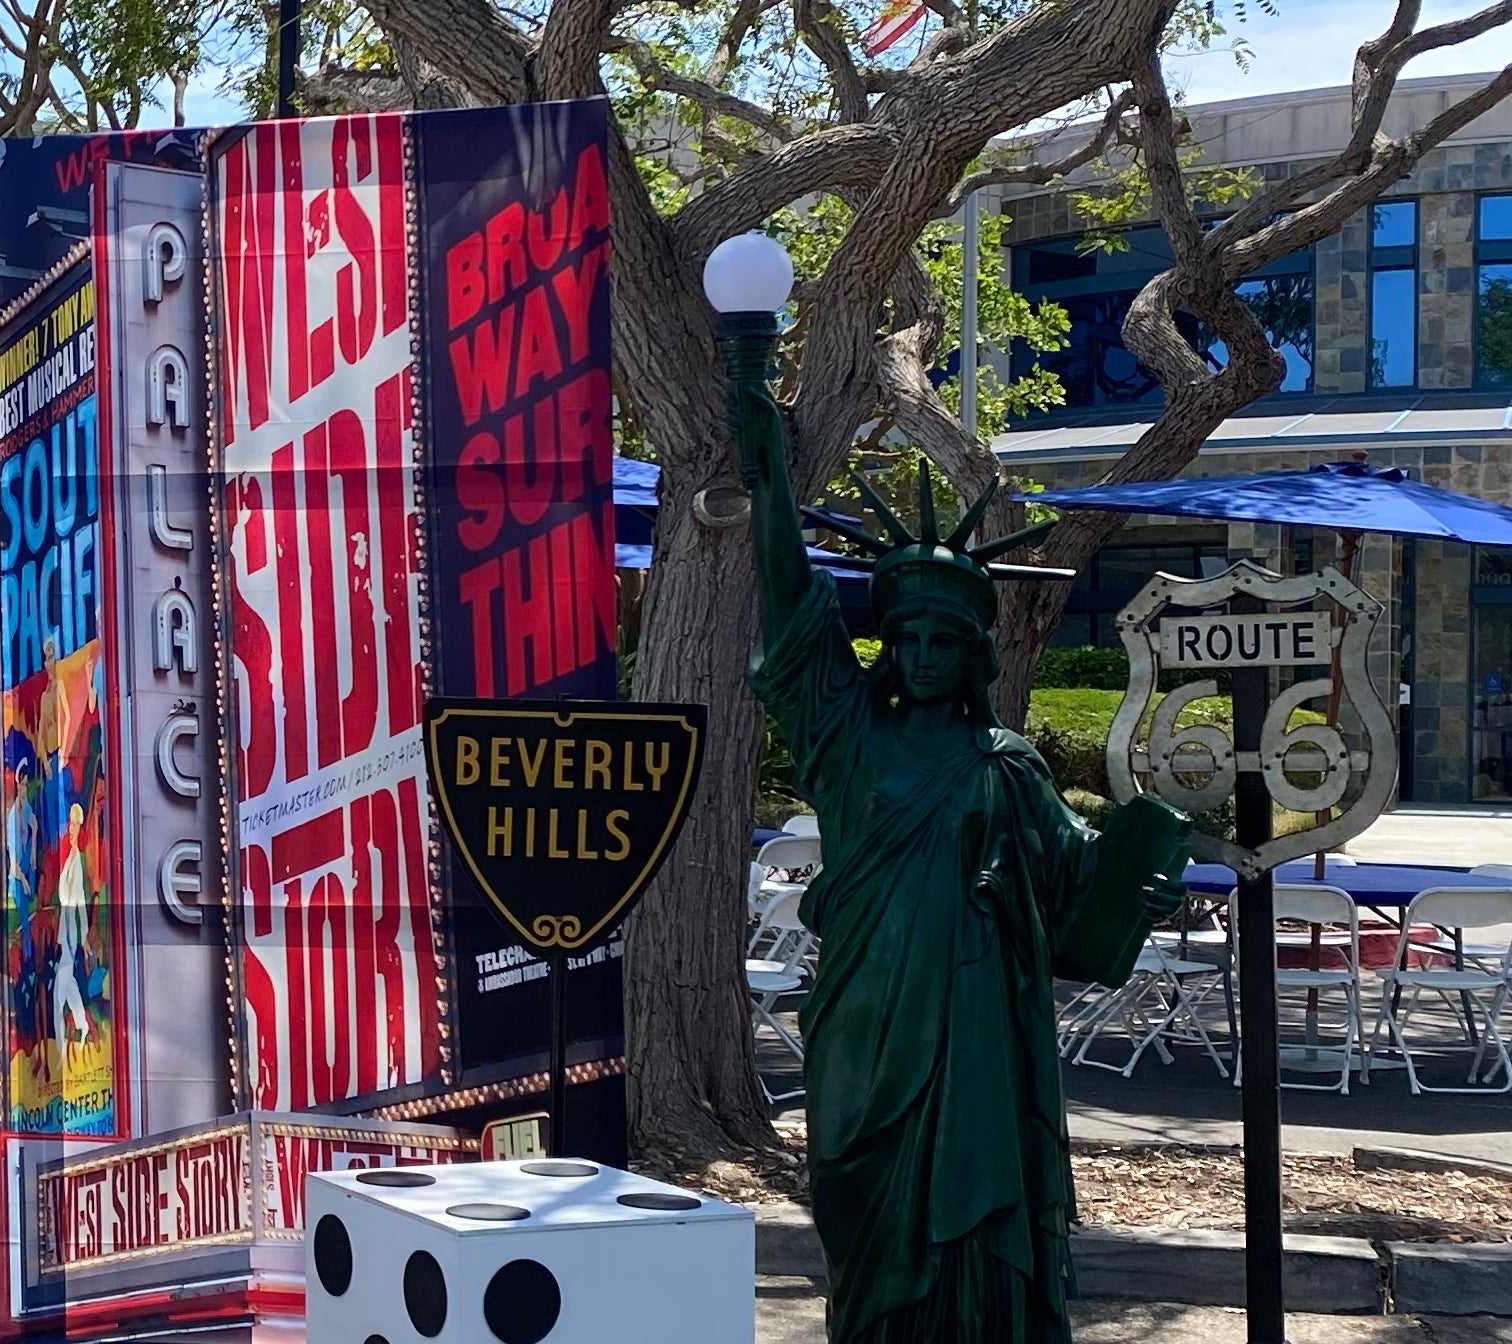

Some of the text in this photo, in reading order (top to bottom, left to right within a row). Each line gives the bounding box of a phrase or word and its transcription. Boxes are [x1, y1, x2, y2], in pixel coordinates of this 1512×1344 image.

[52, 290, 80, 349] TONY
[28, 341, 77, 417] MUSICAL
[455, 368, 611, 552] SUR
[142, 222, 204, 925] PALACE
[460, 500, 616, 699] THIN
[1177, 622, 1316, 662] ROUTE
[454, 735, 670, 791] BEVERLY
[1149, 679, 1351, 812] 66
[487, 807, 631, 860] HILLS
[53, 1168, 106, 1264] WEST
[112, 1152, 169, 1252] SIDE
[176, 1135, 242, 1241] STORY
